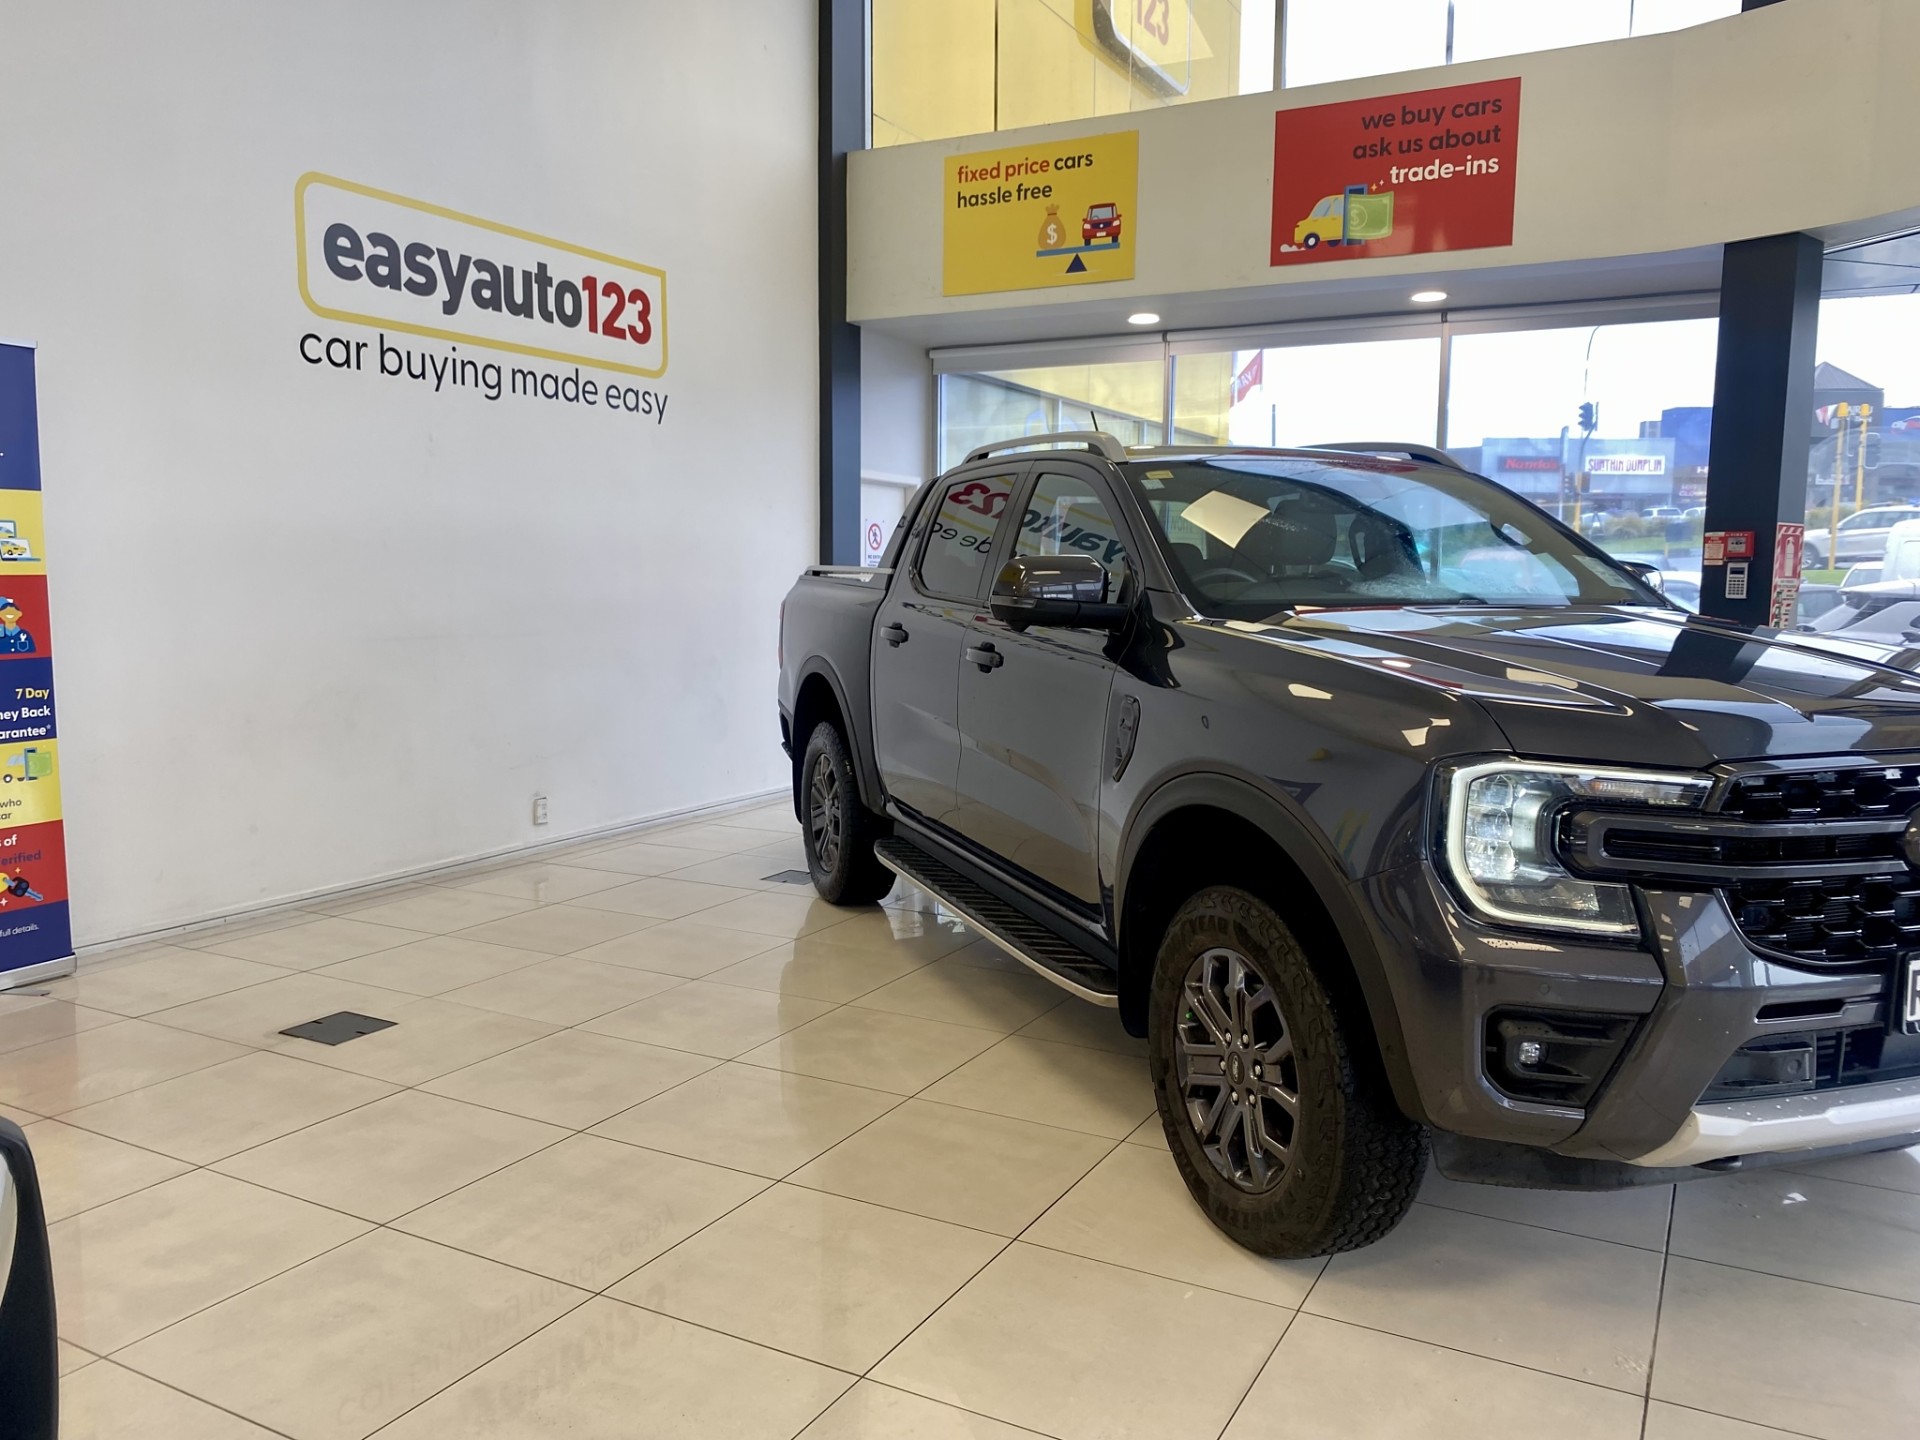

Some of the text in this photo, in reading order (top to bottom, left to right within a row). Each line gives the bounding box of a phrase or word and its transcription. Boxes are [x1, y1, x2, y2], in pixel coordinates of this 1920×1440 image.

[1361, 98, 1503, 130] we buy cars
[1352, 124, 1502, 160] ask us about
[957, 153, 1094, 184] fixed price cars
[1390, 155, 1500, 184] trade-ins
[957, 183, 1053, 209] hassle free
[322, 222, 652, 345] easyauto123
[299, 332, 669, 425] car buying made easy
[15, 687, 50, 700] 7 Day
[21, 705, 51, 718] Back
[0, 798, 22, 808] who
[0, 812, 12, 820] ar
[3, 833, 17, 847] of
[0, 850, 41, 866] erified
